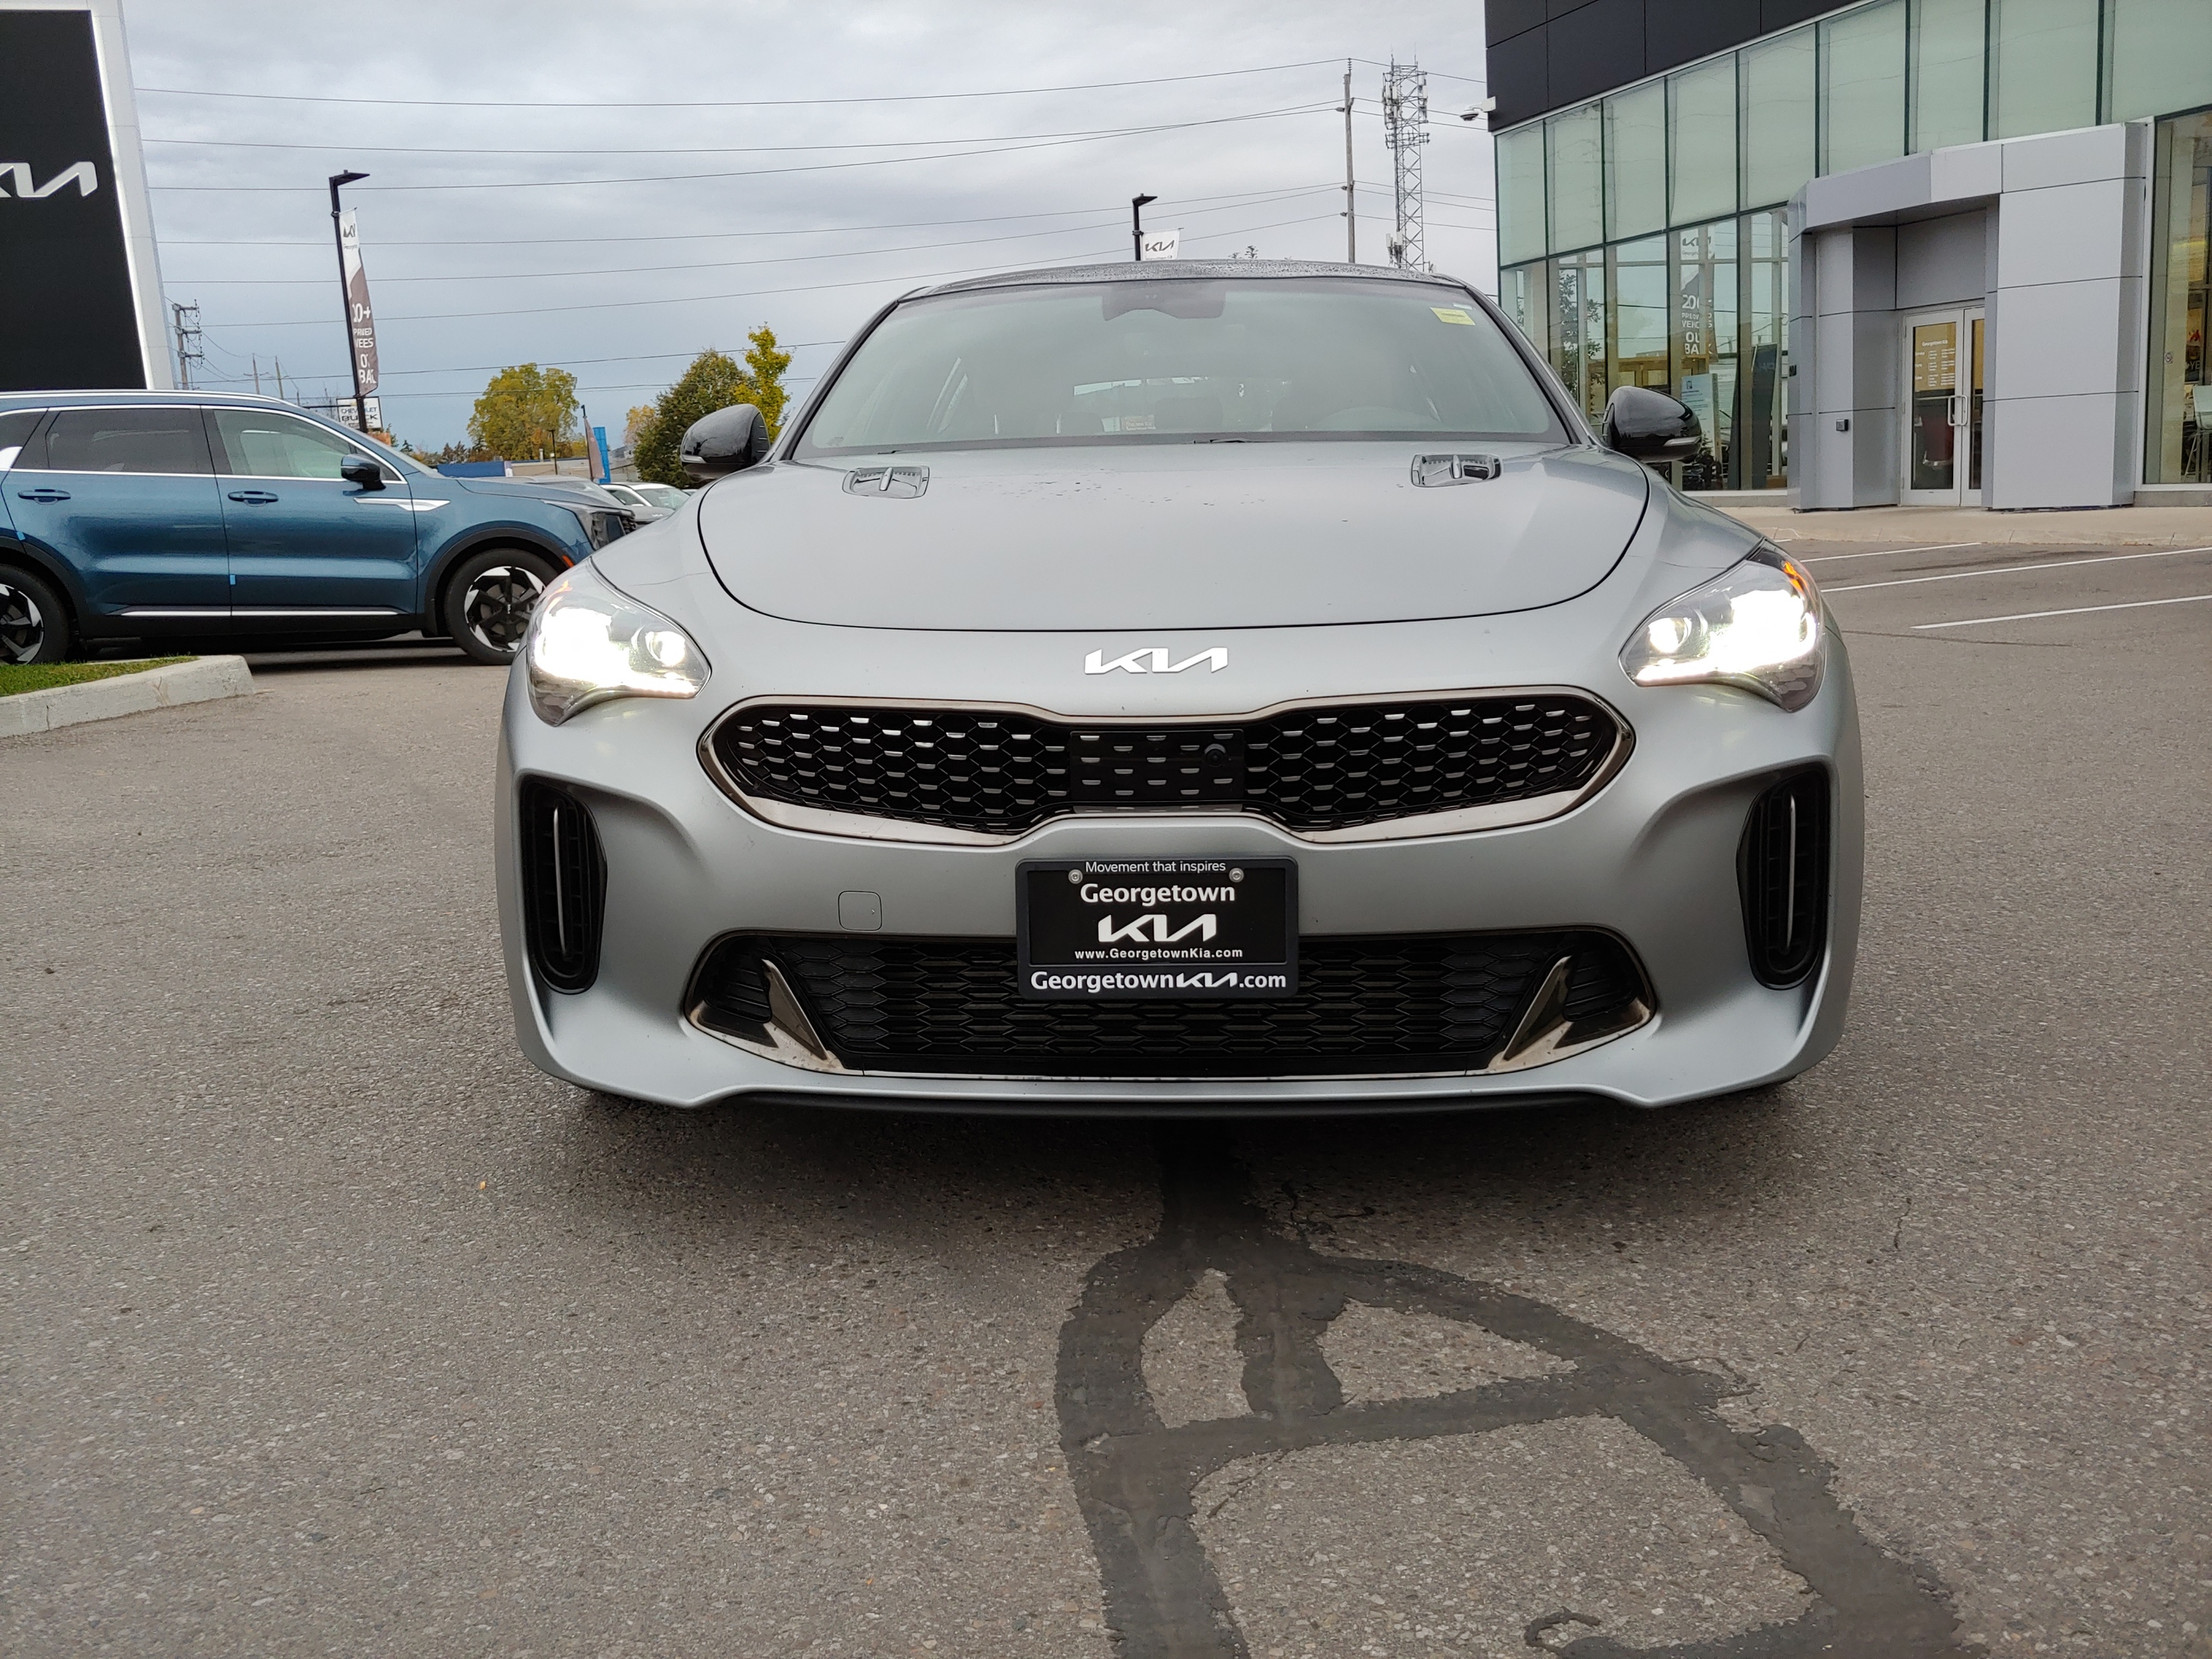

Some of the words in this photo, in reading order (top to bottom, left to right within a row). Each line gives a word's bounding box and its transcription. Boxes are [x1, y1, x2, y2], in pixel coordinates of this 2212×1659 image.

[1145, 240, 1174, 252] KIA
[1084, 647, 1228, 674] KIA
[1085, 861, 1149, 873] Movement
[1152, 861, 1176, 873] that
[1180, 861, 1226, 874] inspires
[1080, 883, 1236, 906] Georgetown
[1098, 914, 1217, 942] KIA
[1075, 948, 1243, 961] www.GeorgetownKia.com
